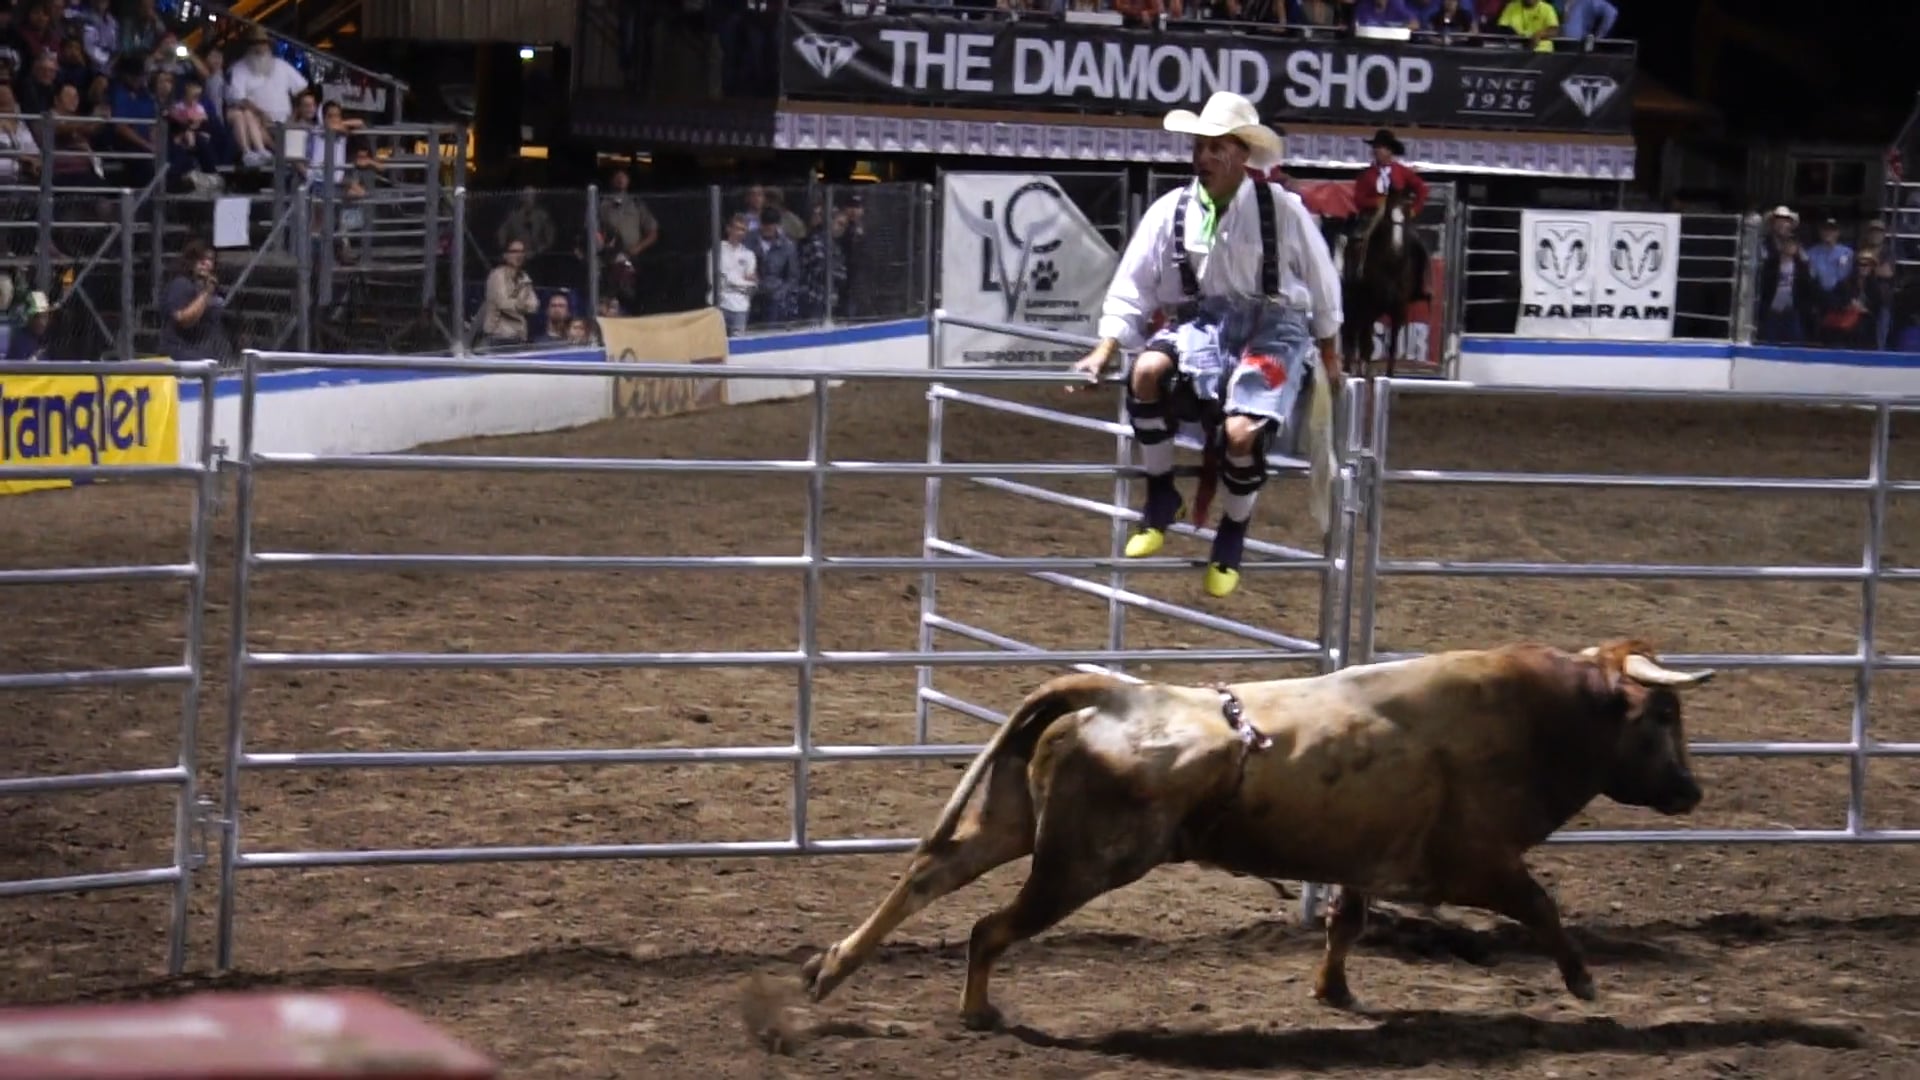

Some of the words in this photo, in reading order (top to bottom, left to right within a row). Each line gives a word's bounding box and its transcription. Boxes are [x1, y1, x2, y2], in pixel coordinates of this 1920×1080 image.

[879, 30, 995, 92] THE
[1013, 37, 1270, 104] DIAMOND
[1284, 50, 1434, 113] SHOP
[1461, 76, 1535, 91] SINCE
[1465, 92, 1533, 110] 1926
[1523, 303, 1593, 318] RAM
[1596, 303, 1669, 320] RAM
[0, 374, 151, 485] rangler
